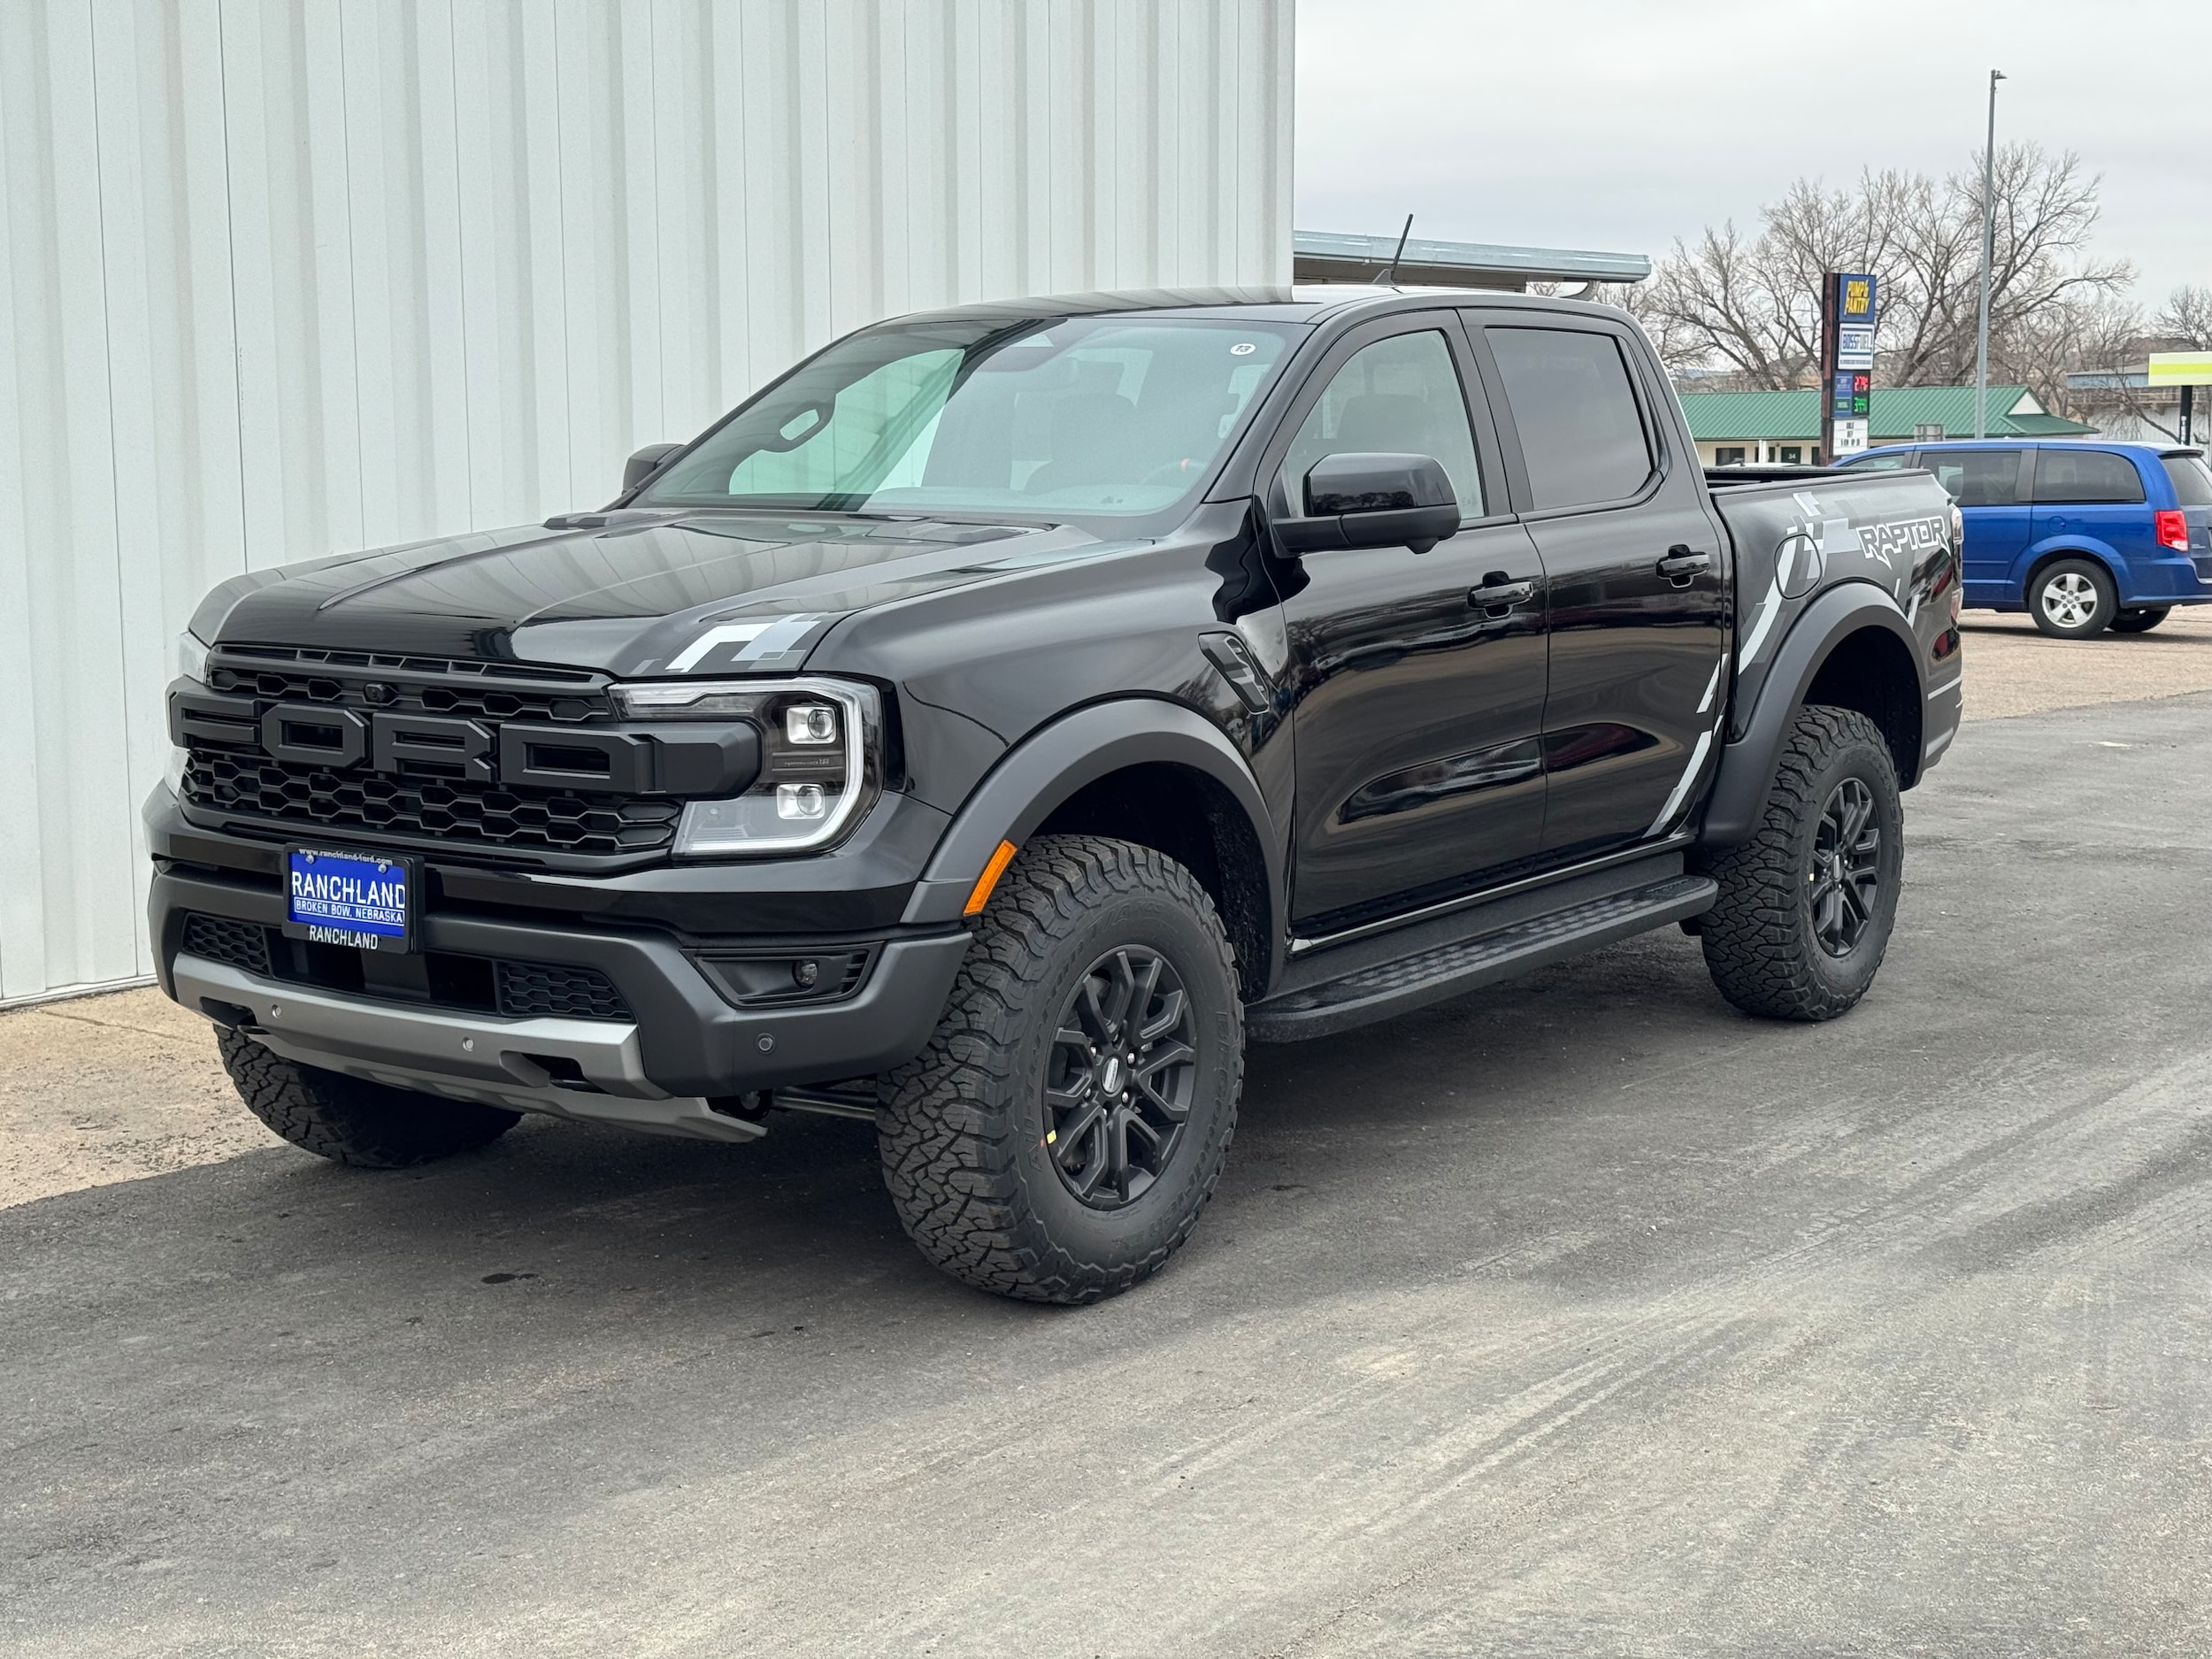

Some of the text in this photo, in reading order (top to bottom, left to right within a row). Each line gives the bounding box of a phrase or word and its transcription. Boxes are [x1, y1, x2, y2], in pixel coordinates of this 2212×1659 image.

[1855, 515, 1952, 570] RAPTOR
[169, 691, 644, 795] FORD
[291, 871, 405, 909] RANCHLAND
[296, 899, 328, 914] BROKEN
[356, 907, 403, 923] NEBRASKA
[310, 925, 378, 949] RANCHLAND
